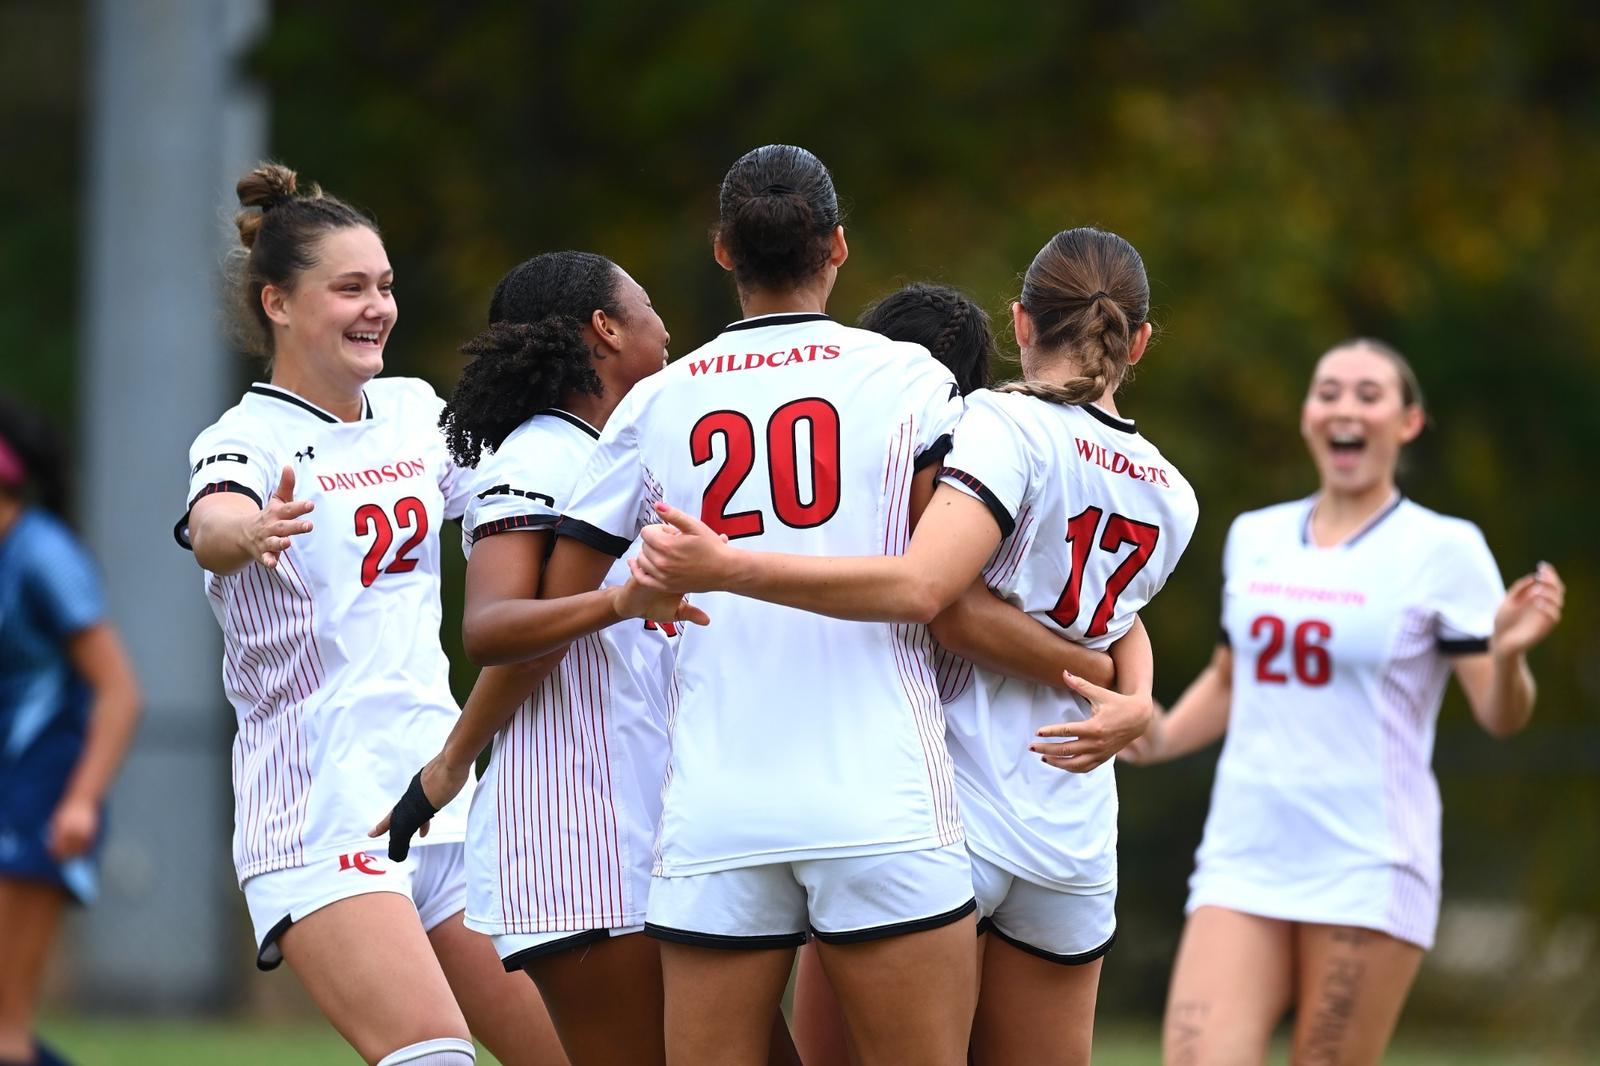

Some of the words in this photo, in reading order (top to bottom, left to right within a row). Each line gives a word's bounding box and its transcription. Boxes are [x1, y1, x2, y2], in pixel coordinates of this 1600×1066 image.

[689, 345, 841, 376] WILDCATS
[317, 458, 425, 492] DAVIDSON
[690, 397, 841, 540] 20
[354, 496, 429, 588] 22
[1045, 505, 1160, 638] 17
[1250, 614, 1333, 687] 26
